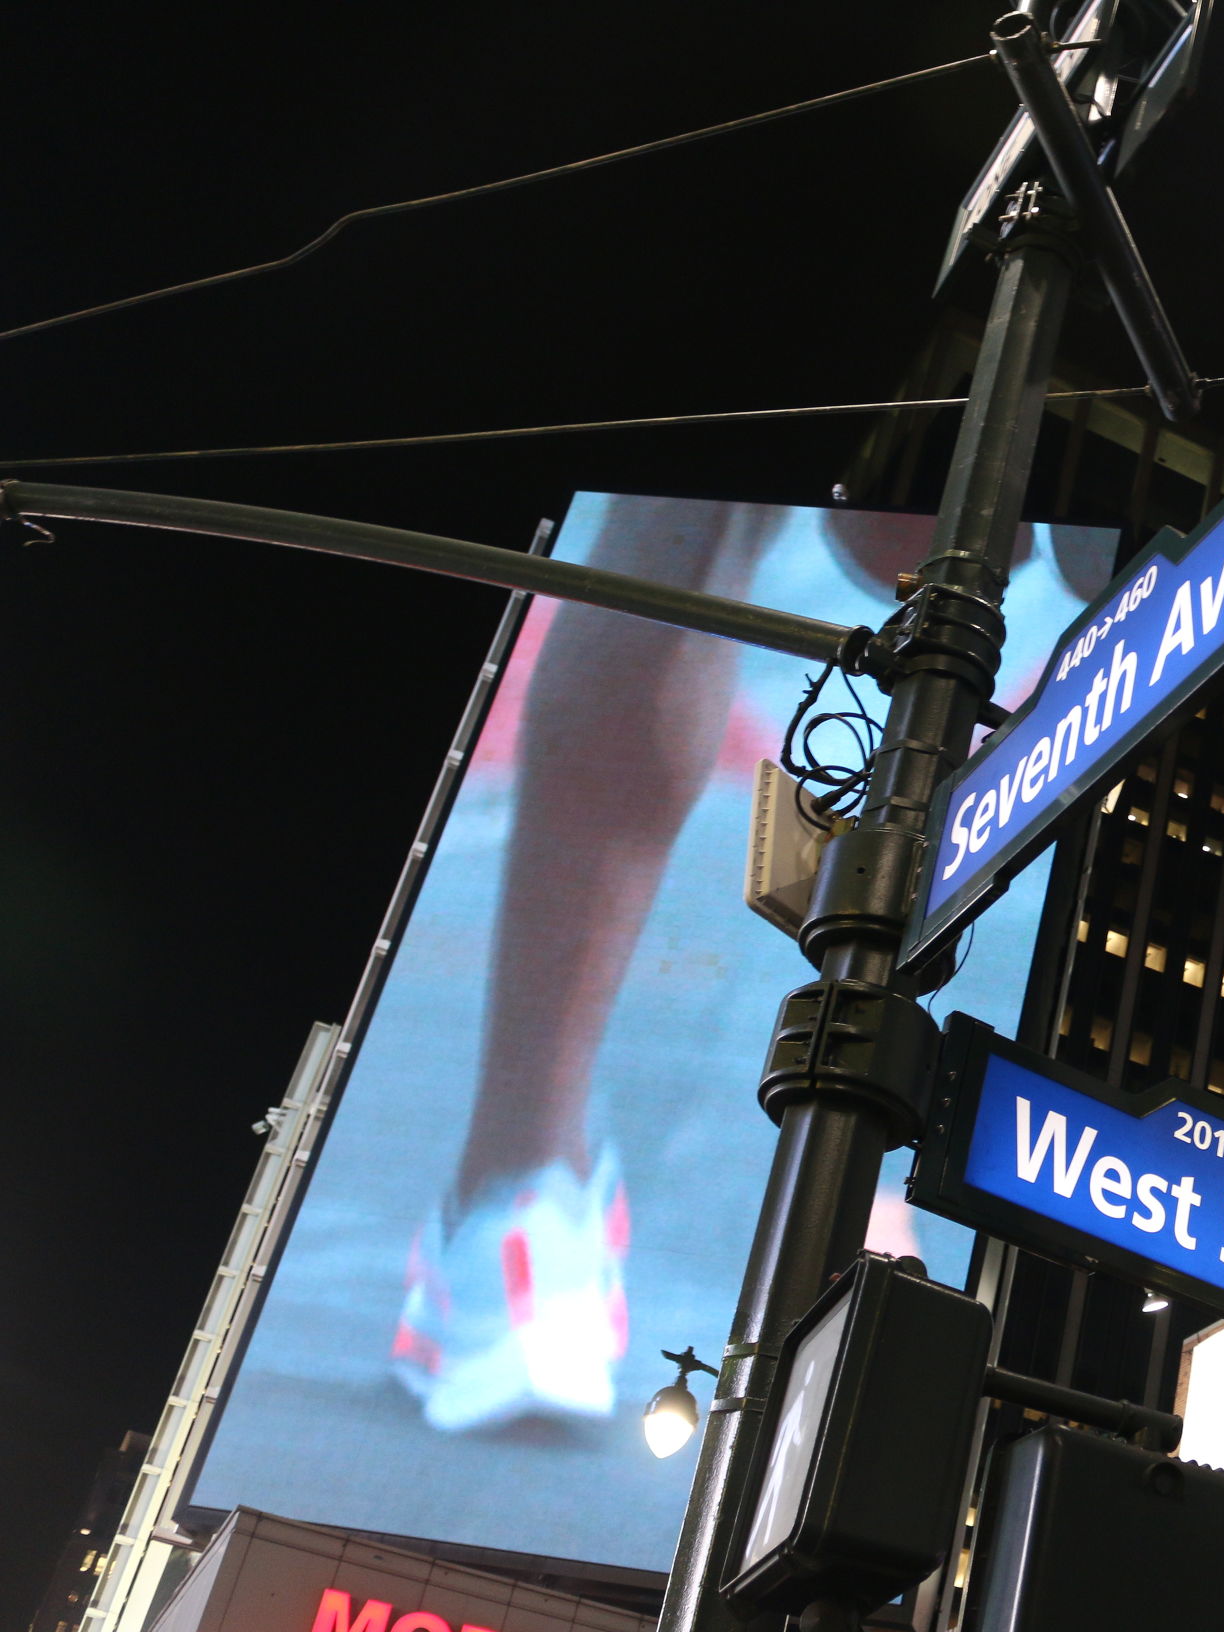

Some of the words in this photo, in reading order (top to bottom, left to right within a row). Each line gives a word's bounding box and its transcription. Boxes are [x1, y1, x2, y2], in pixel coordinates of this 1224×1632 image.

[1056, 625, 1098, 682] 440
[1114, 565, 1158, 623] 460
[942, 640, 1138, 881] Seventh
[1016, 1096, 1202, 1251] West
